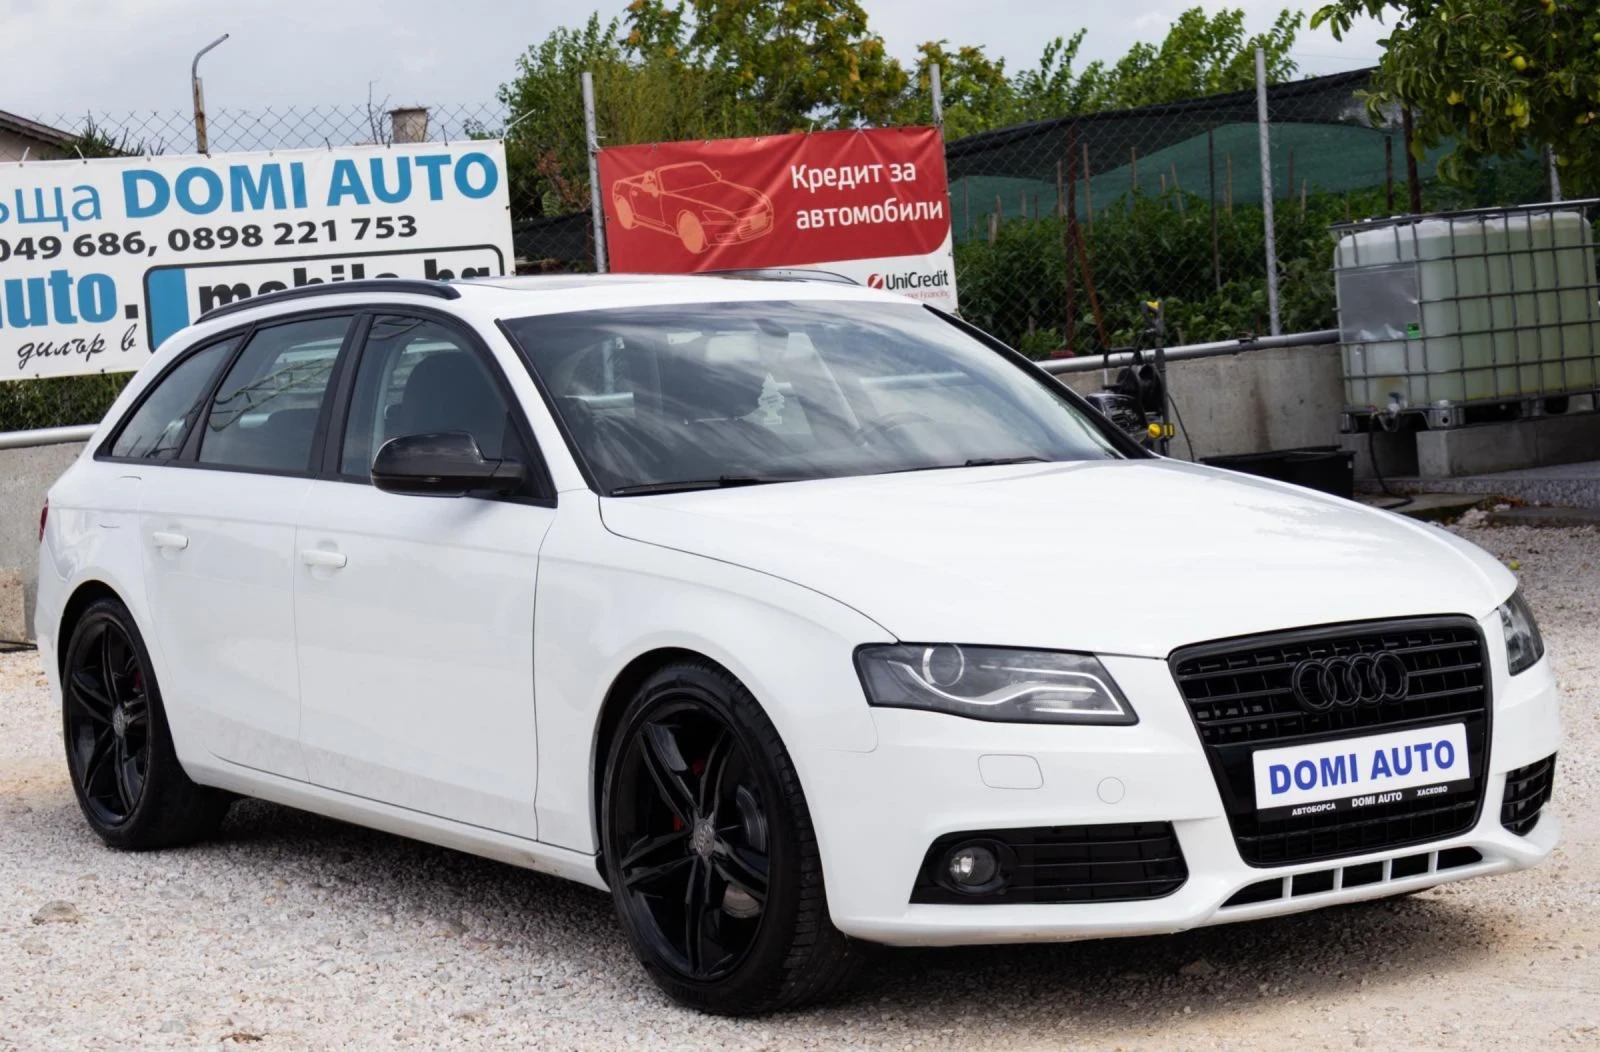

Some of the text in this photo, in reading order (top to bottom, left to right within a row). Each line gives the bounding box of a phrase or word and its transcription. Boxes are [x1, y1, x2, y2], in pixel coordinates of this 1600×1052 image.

[0, 152, 499, 232] ща DOMI AUTO
[791, 162, 917, 193] Кредит за
[796, 198, 944, 230] автомобили
[73, 231, 157, 257] 686,
[168, 224, 263, 251] 0898
[273, 219, 337, 246] 221
[351, 215, 418, 241] 753
[885, 270, 949, 290] UniCredit
[0, 269, 139, 329] uto.
[17, 333, 106, 370] дилър
[1269, 739, 1455, 795] DOMI AUTO
[1291, 785, 1448, 816] АВТОБОРСА DOMI AUTO ХАСКОВО
